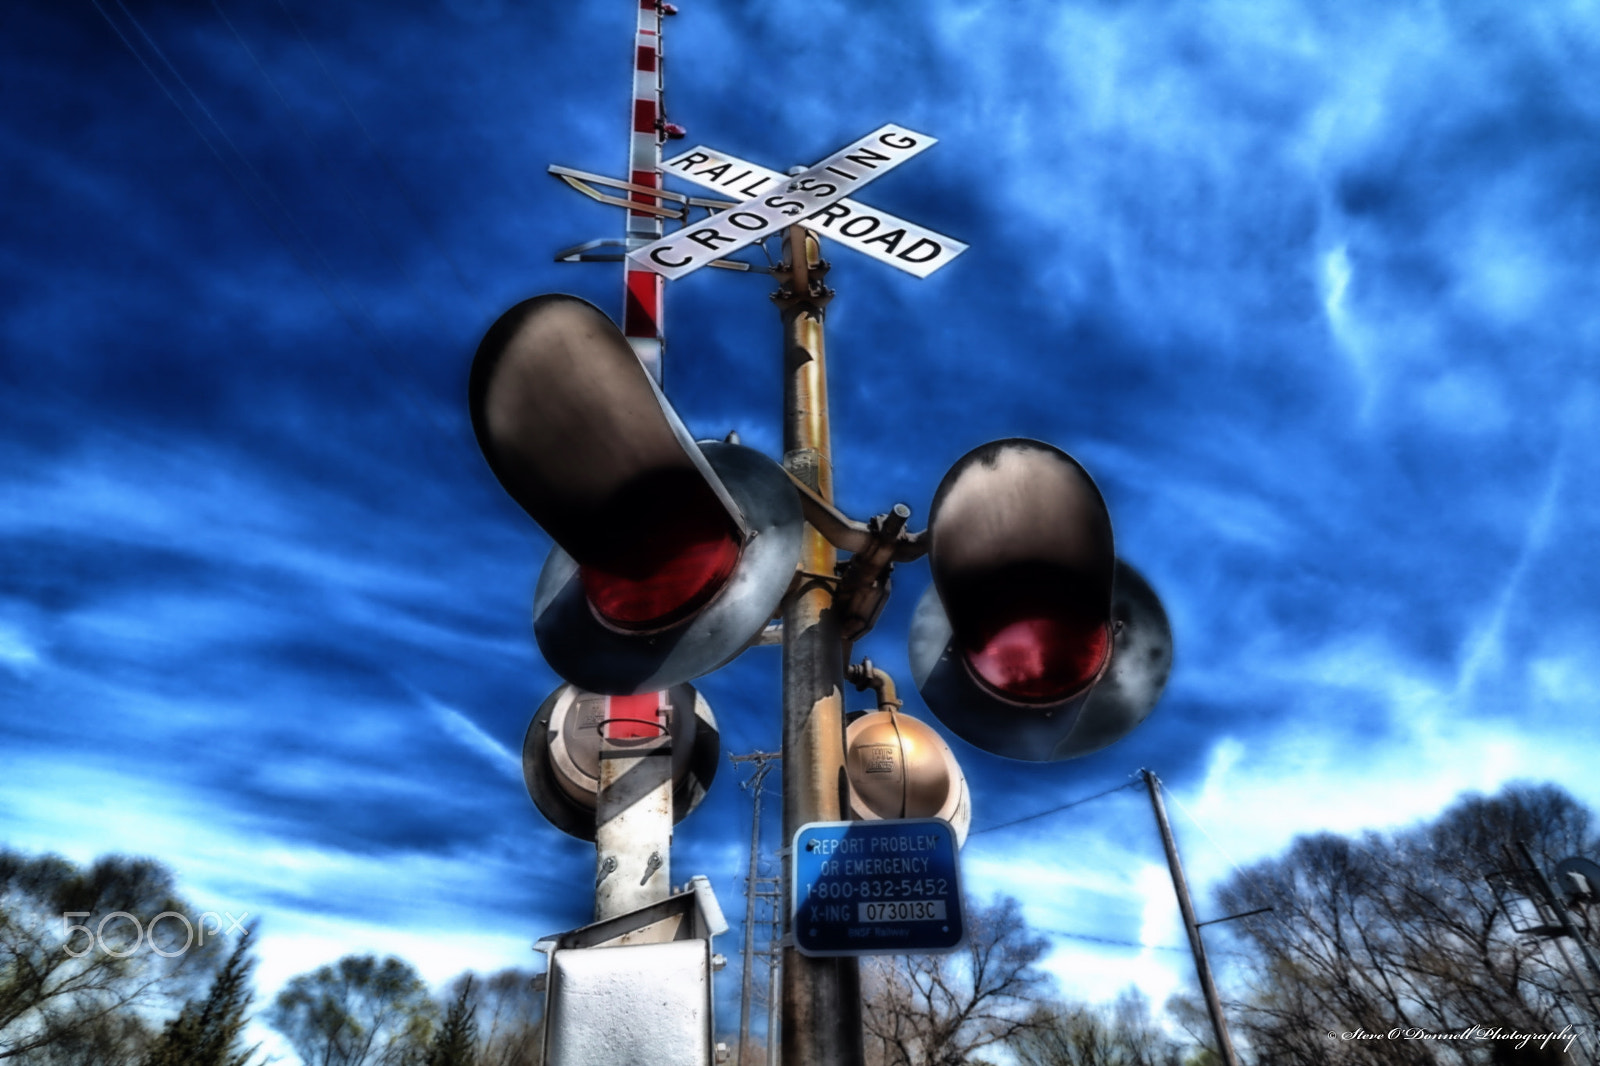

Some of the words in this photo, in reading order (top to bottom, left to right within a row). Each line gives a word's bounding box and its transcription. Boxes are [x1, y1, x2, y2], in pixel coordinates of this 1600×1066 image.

[650, 132, 918, 269] CROSSING
[670, 152, 772, 198] RAIL
[808, 200, 942, 264] ROAD
[813, 838, 865, 855] REPORT
[871, 836, 937, 852] PROBLEM
[821, 861, 840, 876] OR
[845, 857, 930, 875] EMERGENCY
[806, 879, 948, 899] 1-800-832-5452
[810, 905, 850, 922] X-ING
[866, 902, 936, 920] 073013C
